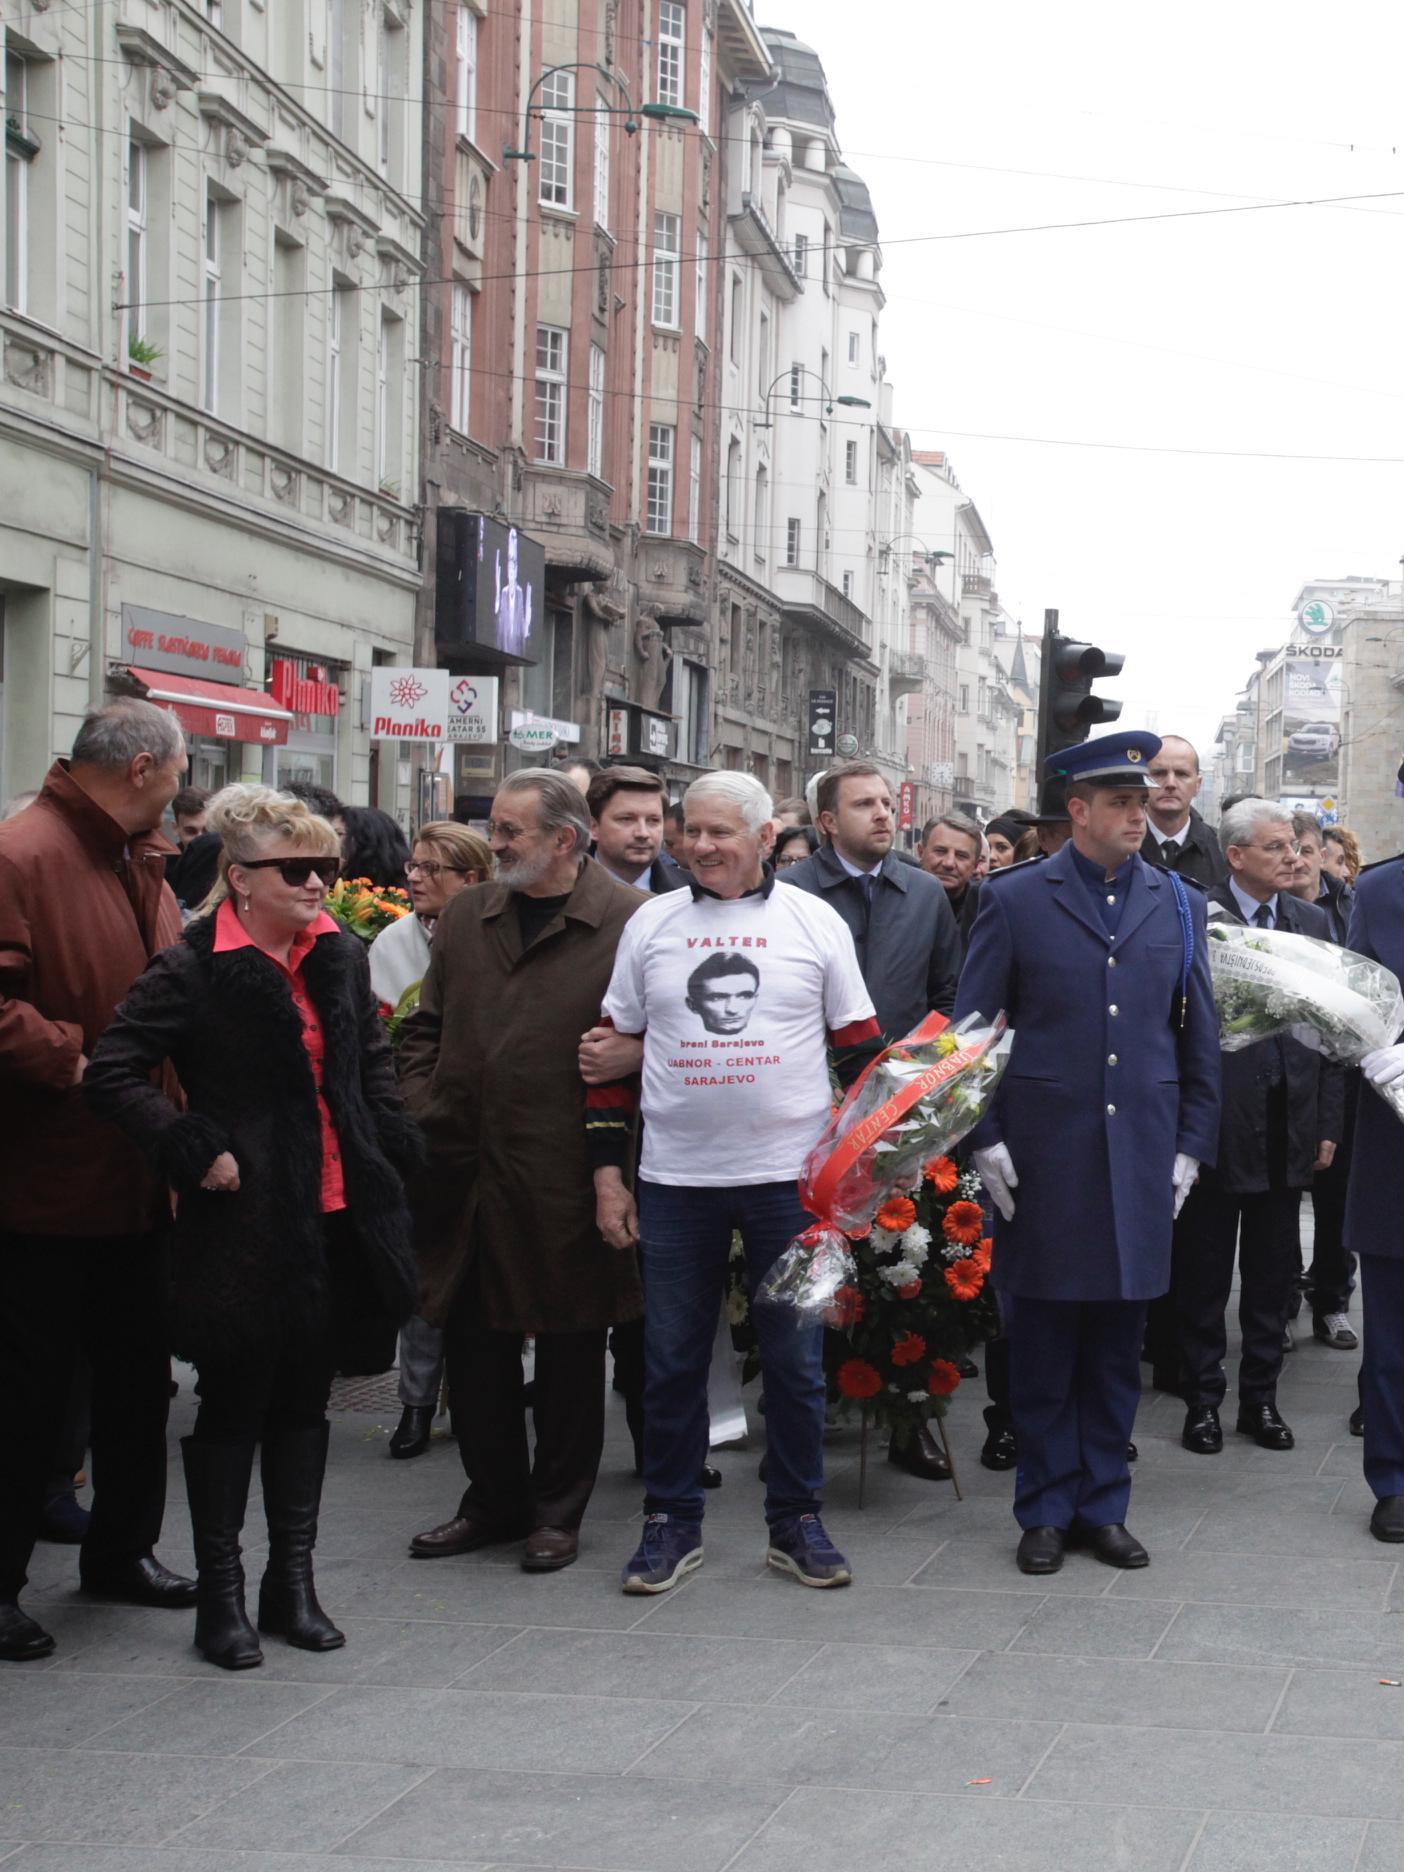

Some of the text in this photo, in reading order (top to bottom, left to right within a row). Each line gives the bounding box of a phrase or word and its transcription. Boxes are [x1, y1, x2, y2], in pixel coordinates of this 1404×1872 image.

[273, 658, 339, 715] Planika
[374, 717, 442, 737] Planika
[686, 936, 768, 949] VALTER
[726, 1055, 781, 1068] CENTAR
[684, 1074, 755, 1086] SARAJEVO
[848, 1051, 974, 1151] UABNOR CENTAR
